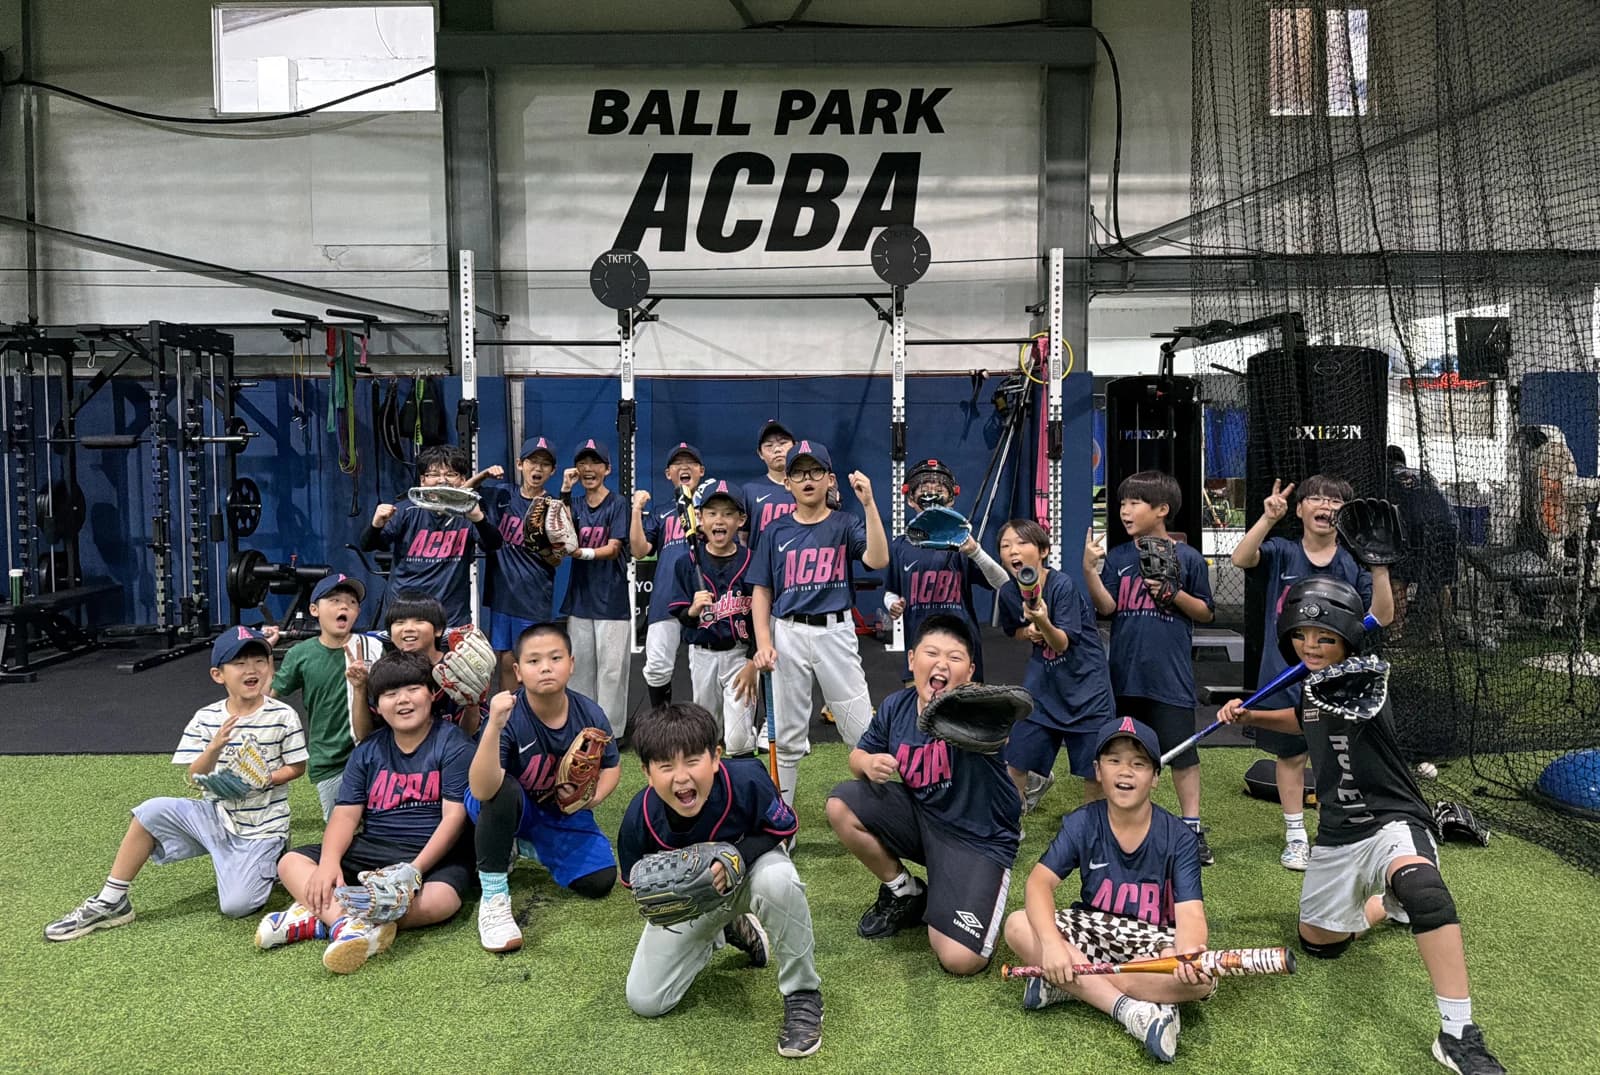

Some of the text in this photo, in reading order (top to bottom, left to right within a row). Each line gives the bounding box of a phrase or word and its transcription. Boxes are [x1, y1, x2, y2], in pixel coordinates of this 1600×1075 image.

[587, 87, 952, 136] BALL PARK
[610, 151, 922, 253] ACBA
[606, 254, 633, 264] TKFIT
[407, 527, 469, 558] ACBA
[784, 544, 847, 589] ACBA
[910, 570, 962, 606] ACBA
[1119, 715, 1137, 735] A
[367, 769, 440, 810] ACBA
[1091, 878, 1176, 925] ACBA
[953, 918, 981, 939] UMBRO
